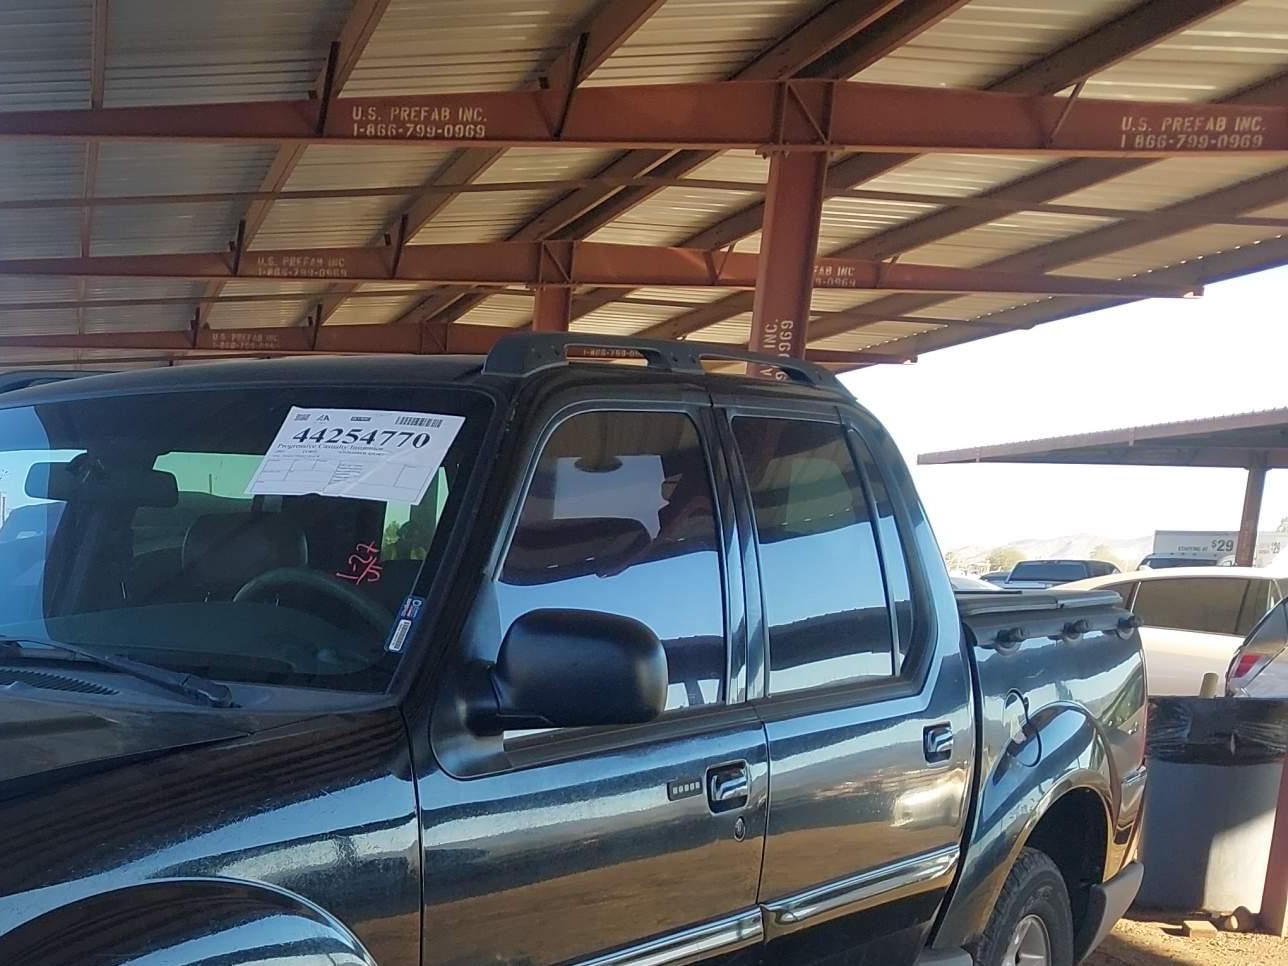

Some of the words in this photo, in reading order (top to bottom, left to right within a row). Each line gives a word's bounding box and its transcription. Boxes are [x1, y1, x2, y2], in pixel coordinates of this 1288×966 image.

[352, 106, 381, 120] U.S.
[390, 107, 450, 121] PREFAB
[458, 107, 487, 122] INC.
[353, 123, 486, 138] 1-866-799-0969
[1121, 116, 1152, 131] U.S.
[1161, 117, 1227, 132] PREFAB
[1234, 116, 1266, 132] INC.
[292, 427, 431, 449] 44254770
[1212, 539, 1234, 552] $29
